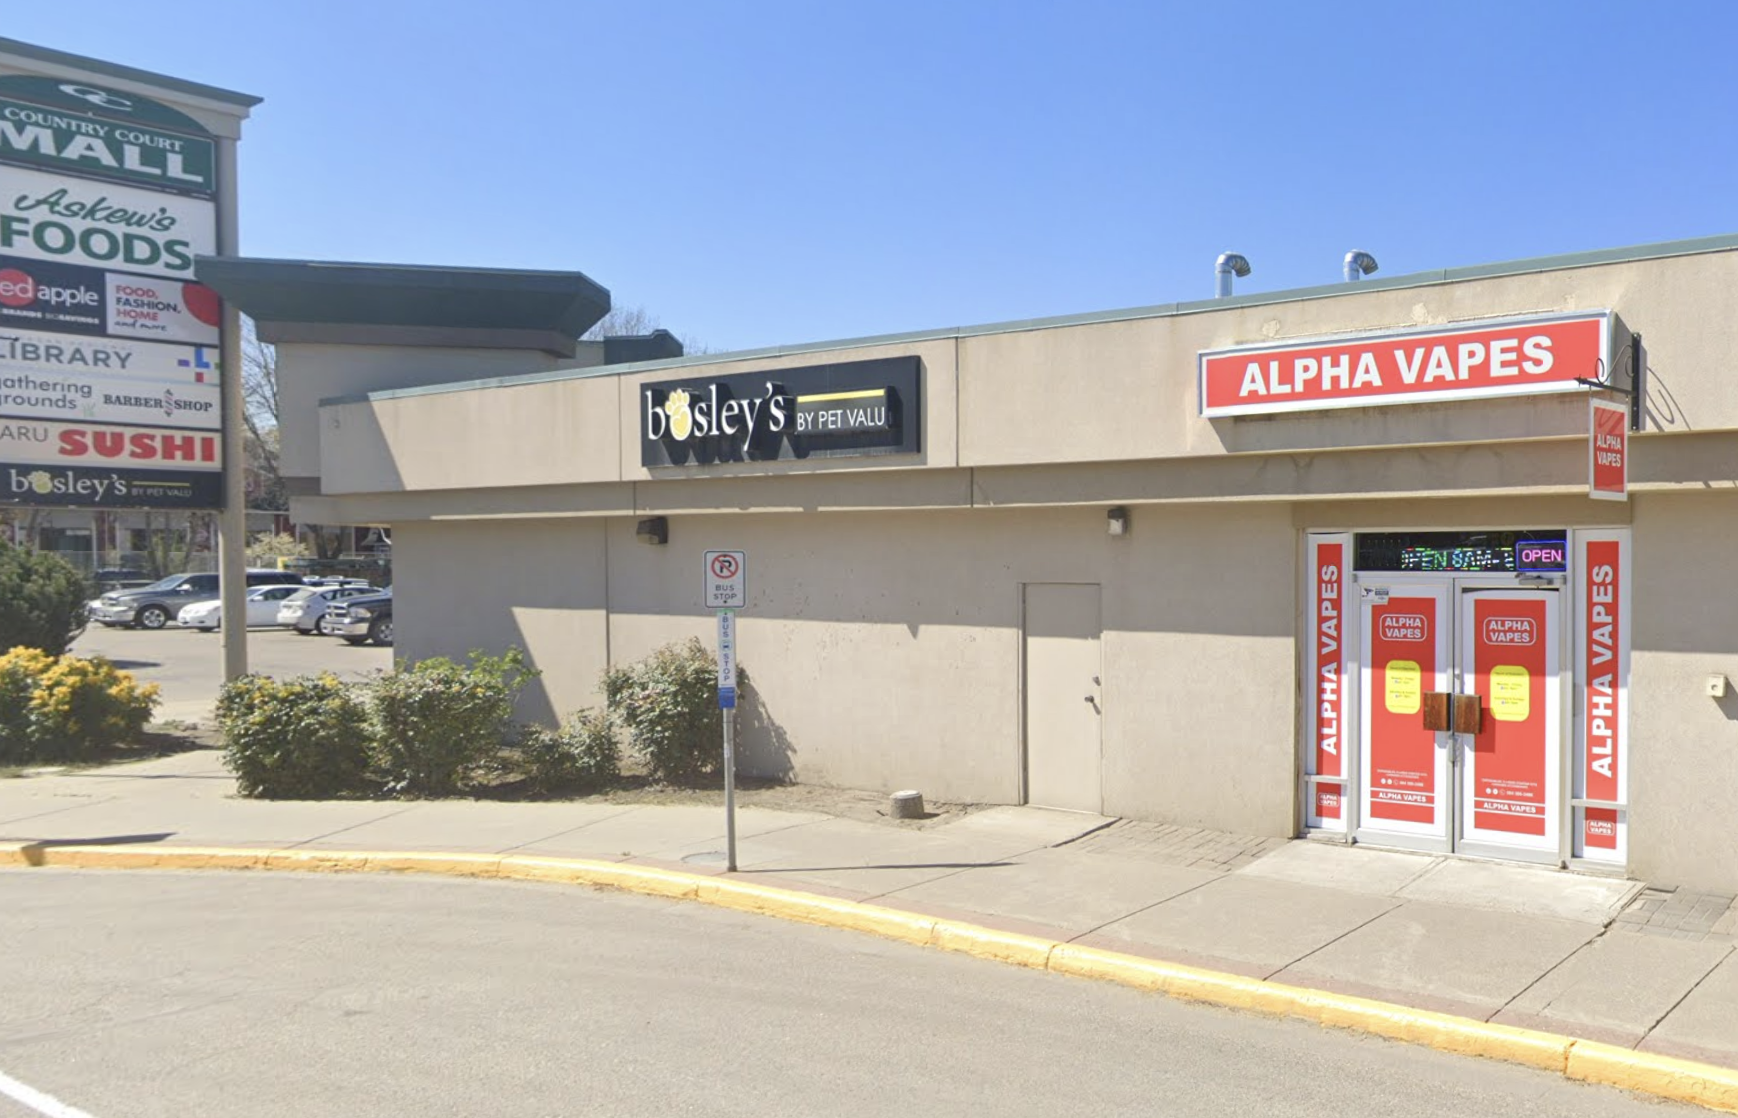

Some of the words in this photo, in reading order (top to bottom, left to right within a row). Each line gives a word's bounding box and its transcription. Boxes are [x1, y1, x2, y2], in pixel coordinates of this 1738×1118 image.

[4, 107, 109, 136] COUNTRY
[115, 129, 183, 152] COURT
[0, 120, 203, 183] MALL
[14, 188, 176, 232] Askew's
[0, 215, 192, 271] FOODS
[0, 276, 33, 298] ed
[37, 285, 99, 307] apple
[115, 285, 158, 299] FOOD,
[116, 308, 158, 321] HOME
[114, 319, 137, 329] and
[1239, 352, 1382, 397] ALPHA
[1394, 335, 1554, 385] VAPES
[0, 375, 92, 398] athering
[0, 394, 77, 410] rounds
[103, 394, 163, 409] BARBER
[174, 399, 213, 412] SHOP
[645, 381, 785, 453] bosley's
[796, 411, 814, 431] BY
[818, 410, 843, 430] PET
[846, 407, 886, 428] VALU
[58, 429, 215, 462] SUSHI
[1596, 433, 1622, 451] ALPHA
[1596, 450, 1622, 468] VAPES
[9, 469, 127, 502] bosley's
[147, 488, 165, 497] PET
[1522, 549, 1562, 563] OPEN
[713, 592, 737, 601] STOP
[715, 584, 735, 592] BUS
[1321, 564, 1339, 656] VAPES
[1592, 564, 1613, 668] VAPES
[1384, 615, 1422, 628] ALPHA
[1489, 620, 1530, 632] ALPHA
[1385, 627, 1422, 638] VAPES
[1490, 631, 1530, 642] VAPES
[723, 653, 731, 682] STOP
[1321, 661, 1338, 755] ALPHA
[1591, 676, 1613, 778] ALPHA
[1378, 792, 1402, 801] ALPHA
[1403, 794, 1427, 803] VAPES
[1483, 802, 1509, 812] ALPHA
[1510, 804, 1536, 814] VAPES
[1590, 820, 1612, 828] ALPHA
[1590, 827, 1612, 835] VAPES
